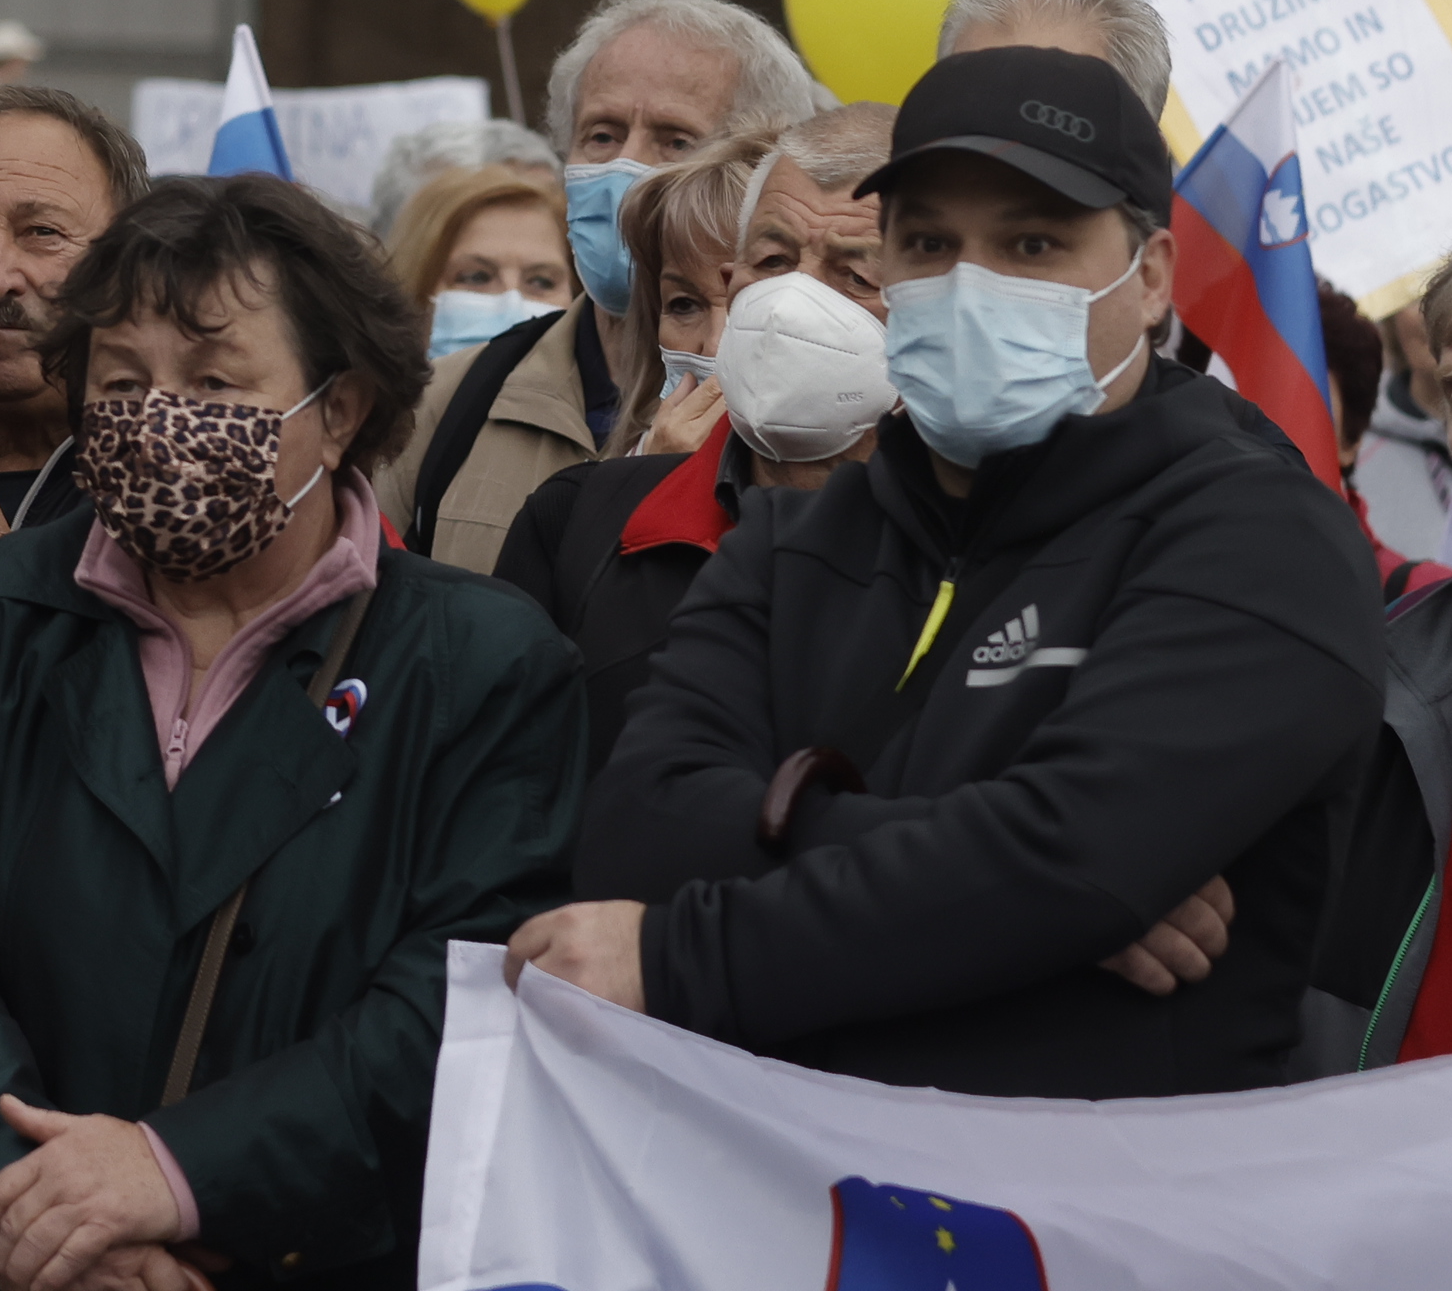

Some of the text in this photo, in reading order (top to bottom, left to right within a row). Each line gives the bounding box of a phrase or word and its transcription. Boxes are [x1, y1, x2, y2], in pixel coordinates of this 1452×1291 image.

[1343, 5, 1385, 44] IN
[1367, 50, 1415, 91] SO
[1315, 114, 1402, 175] NAŠE
